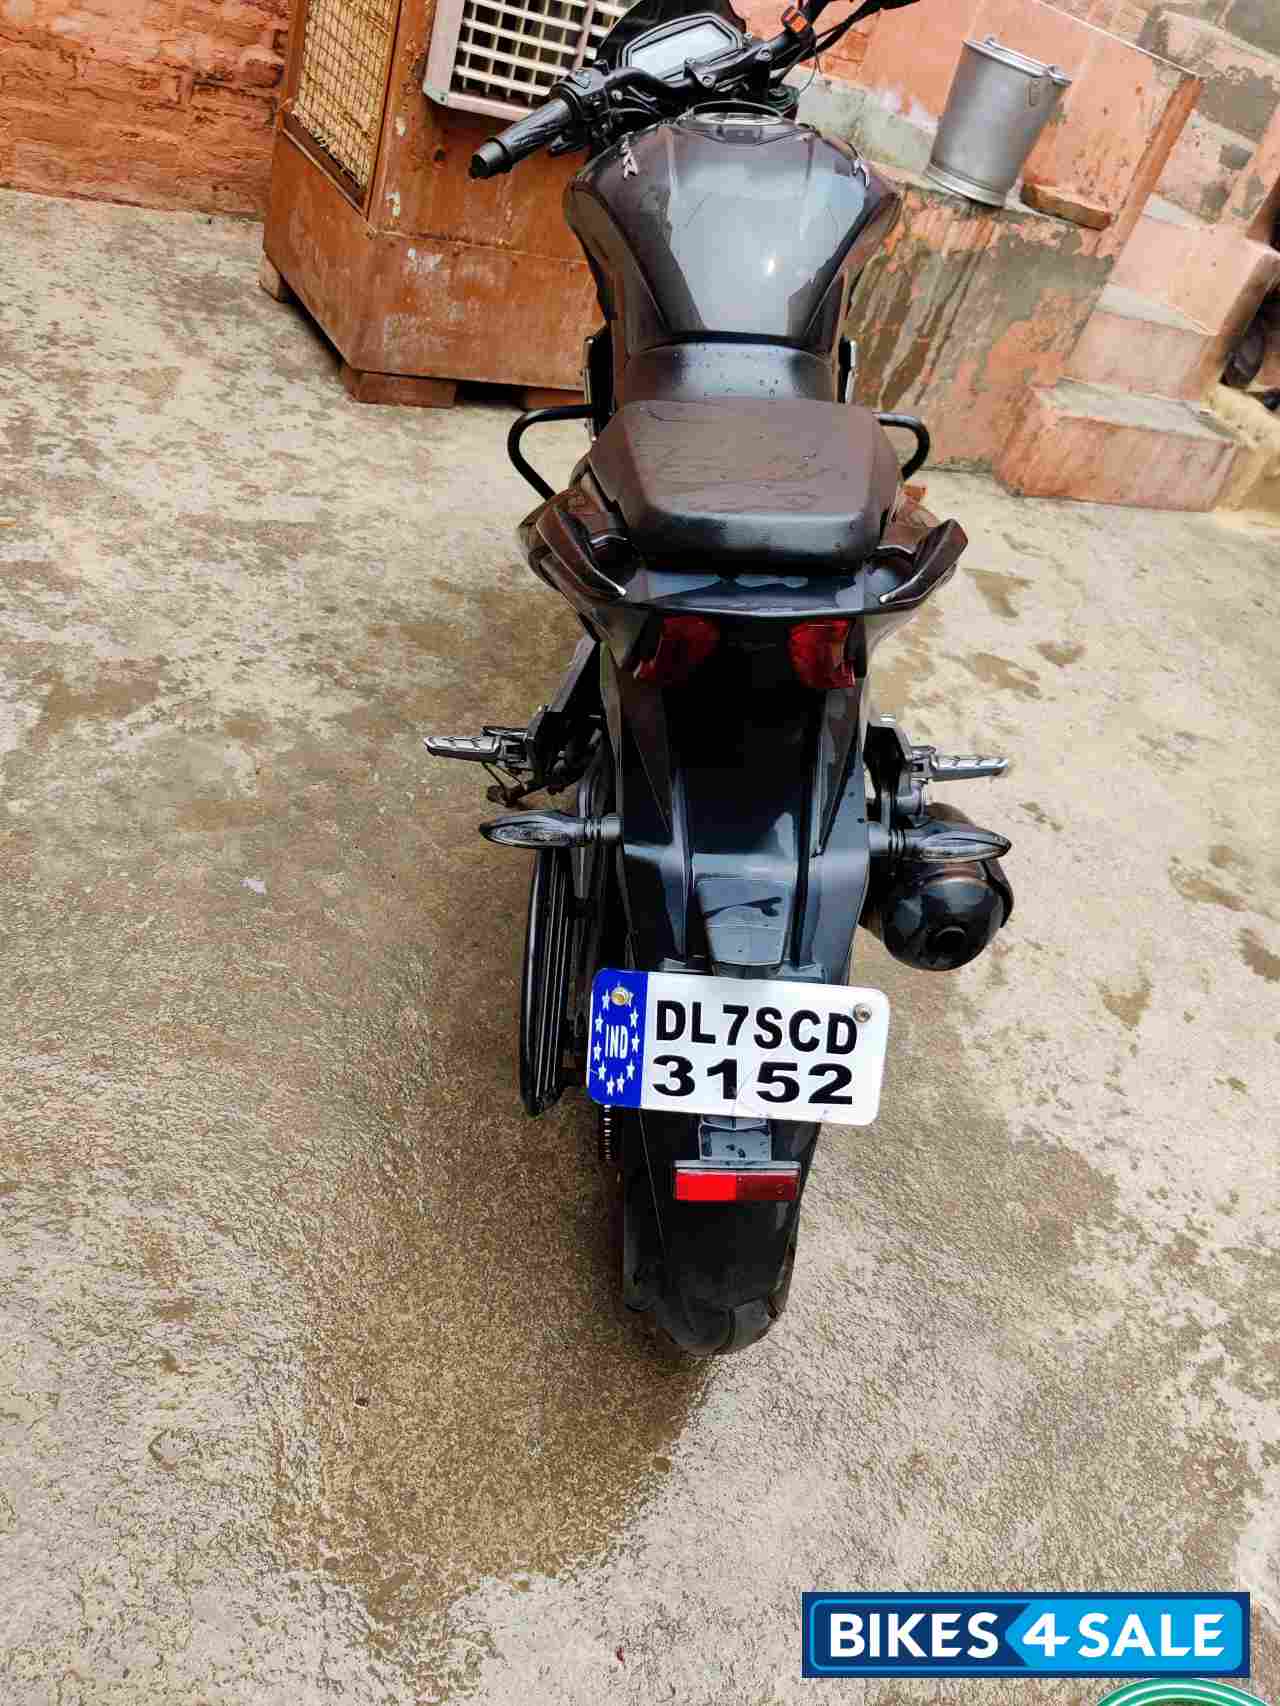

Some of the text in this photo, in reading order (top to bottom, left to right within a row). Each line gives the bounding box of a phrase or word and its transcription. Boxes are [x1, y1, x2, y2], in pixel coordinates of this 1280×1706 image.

[604, 1024, 629, 1059] IND
[656, 1000, 858, 1055] DL7SCD
[653, 1055, 853, 1105] 3152
